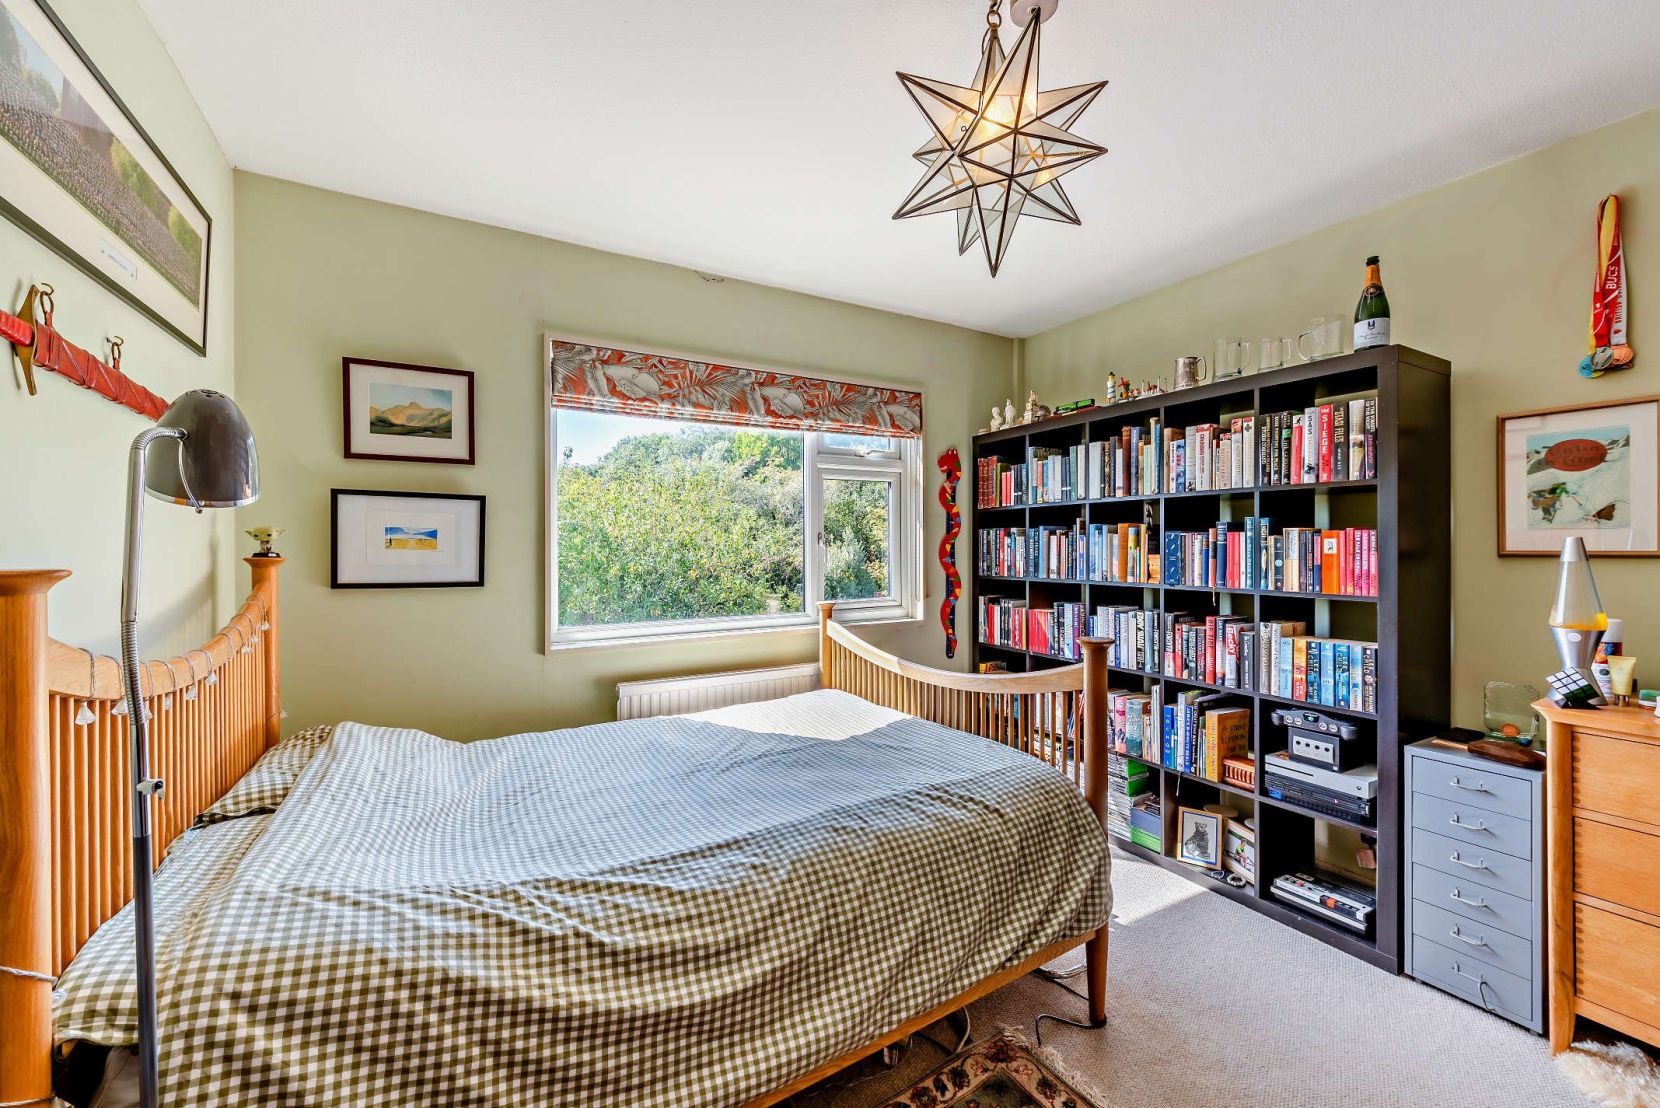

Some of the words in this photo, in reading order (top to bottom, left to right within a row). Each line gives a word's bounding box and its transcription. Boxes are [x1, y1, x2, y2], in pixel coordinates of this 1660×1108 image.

[1606, 266, 1618, 289] BUCS
[1334, 411, 1344, 426] STASI
[1334, 428, 1344, 443] FILES
[1228, 628, 1236, 654] Becky
